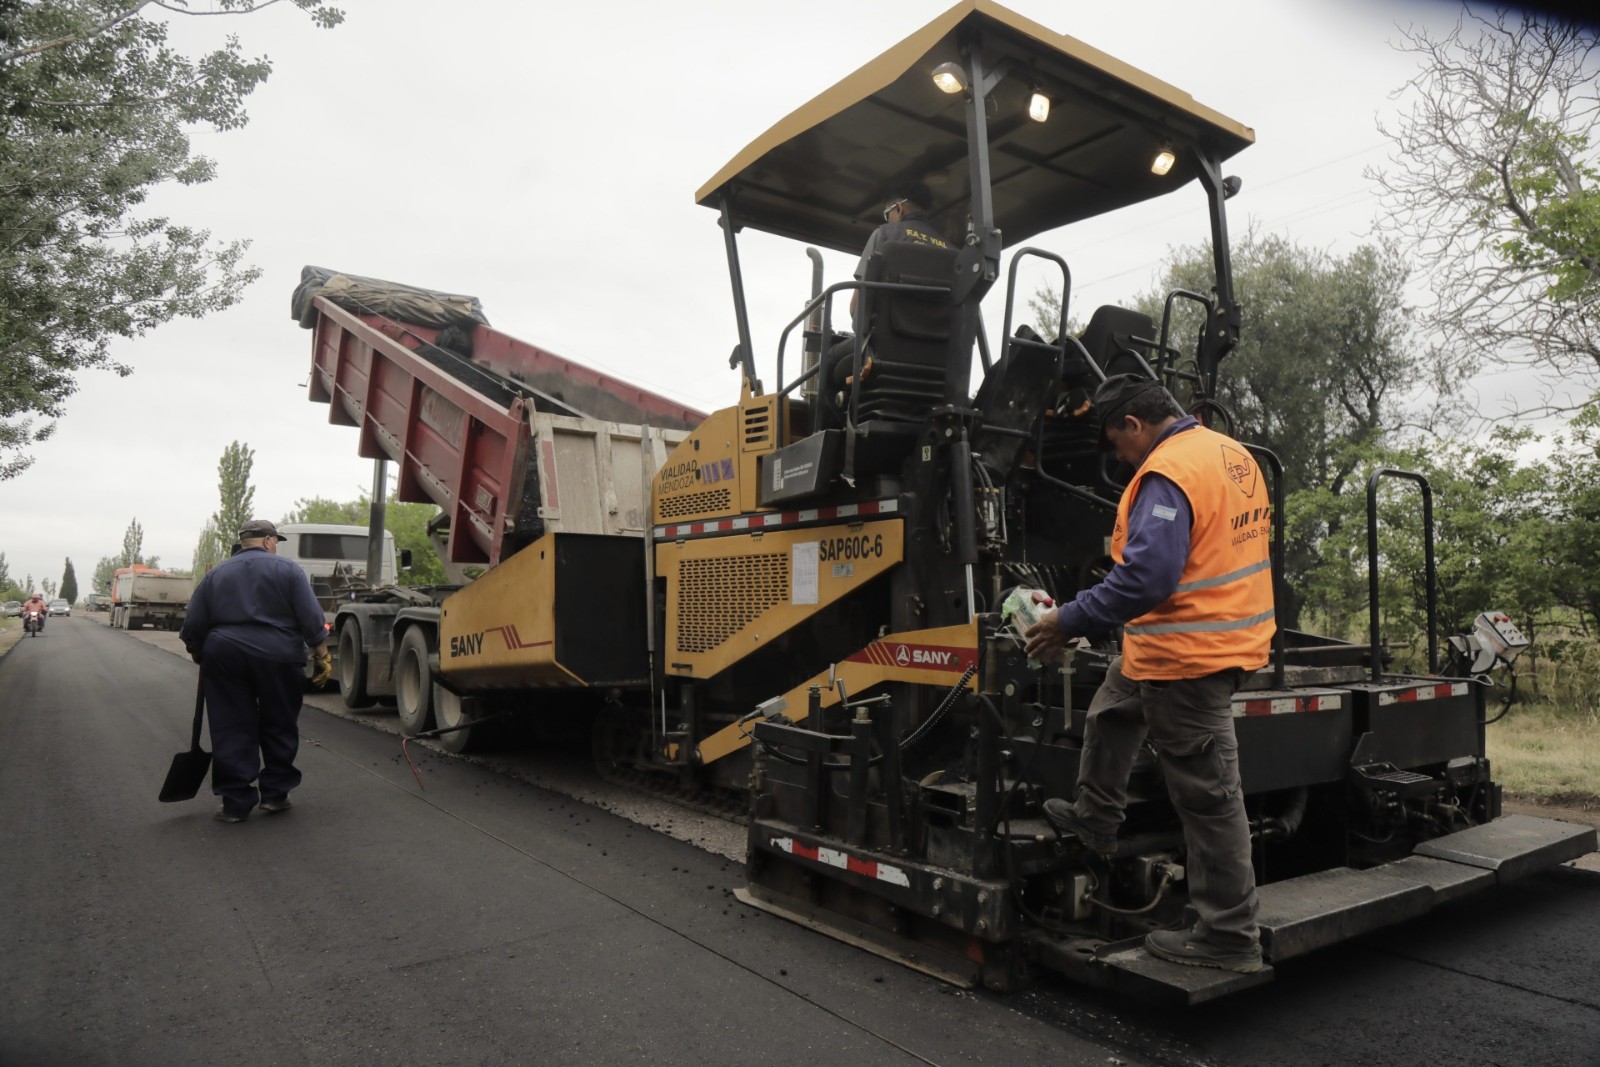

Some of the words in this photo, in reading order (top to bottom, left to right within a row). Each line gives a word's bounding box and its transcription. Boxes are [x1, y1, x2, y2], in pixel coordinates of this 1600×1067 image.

[661, 460, 698, 480] VIALIDAD
[658, 475, 694, 496] MENDOZA
[820, 534, 883, 561] SAP60C-6
[450, 632, 484, 657] SANY
[912, 650, 951, 665] SANY
